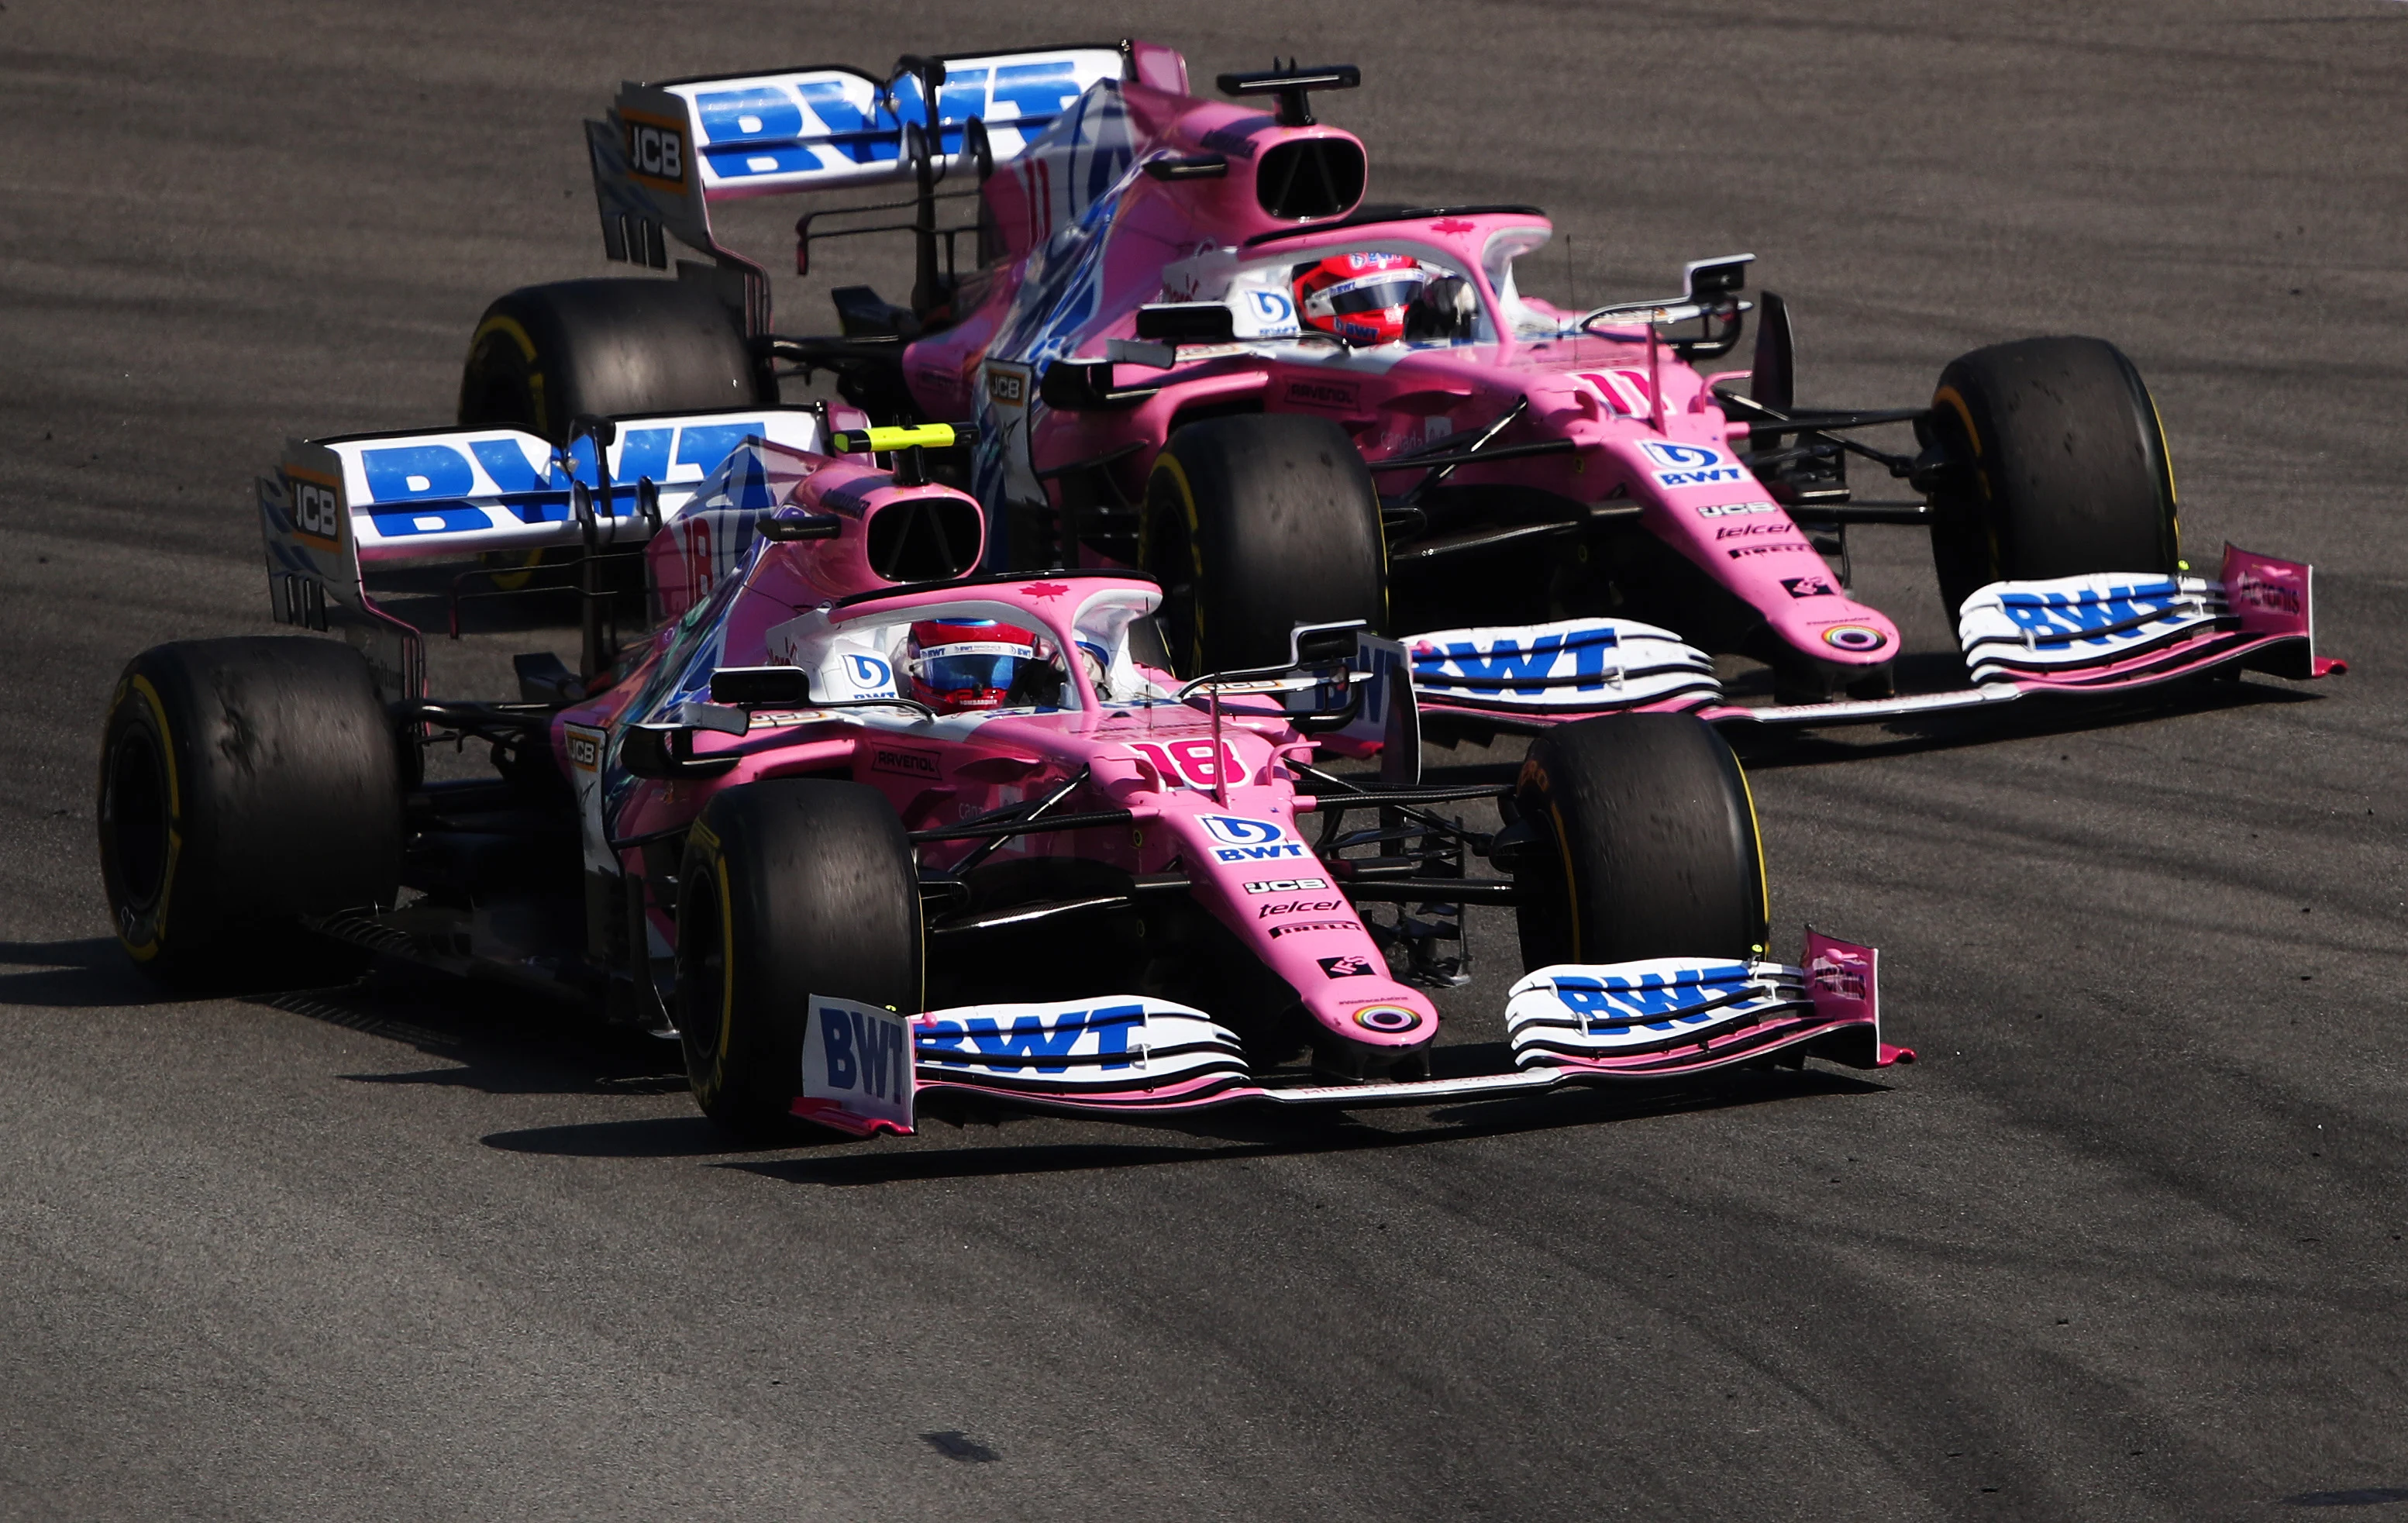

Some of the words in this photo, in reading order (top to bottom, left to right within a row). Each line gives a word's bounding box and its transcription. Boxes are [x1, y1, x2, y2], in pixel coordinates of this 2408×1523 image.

[694, 61, 1082, 178] BWT
[632, 126, 682, 177] JCB
[991, 376, 1020, 399] JCB
[1569, 368, 1674, 416] 11
[360, 422, 767, 537] BWT
[1659, 468, 1743, 486] BWT
[295, 482, 338, 536] JCB
[1697, 501, 1777, 519] JCB
[1716, 522, 1795, 540] telcel
[1999, 583, 2189, 650] BWT
[571, 739, 595, 763] JCB
[877, 750, 936, 773] RAVENOL
[1125, 737, 1250, 789] 18
[1215, 844, 1303, 862] BWT
[1244, 877, 1328, 894] JCB
[1259, 900, 1342, 919] telcel
[1330, 955, 1369, 975] IFS
[1551, 965, 1762, 1035] BWT
[820, 1008, 903, 1106] BWT
